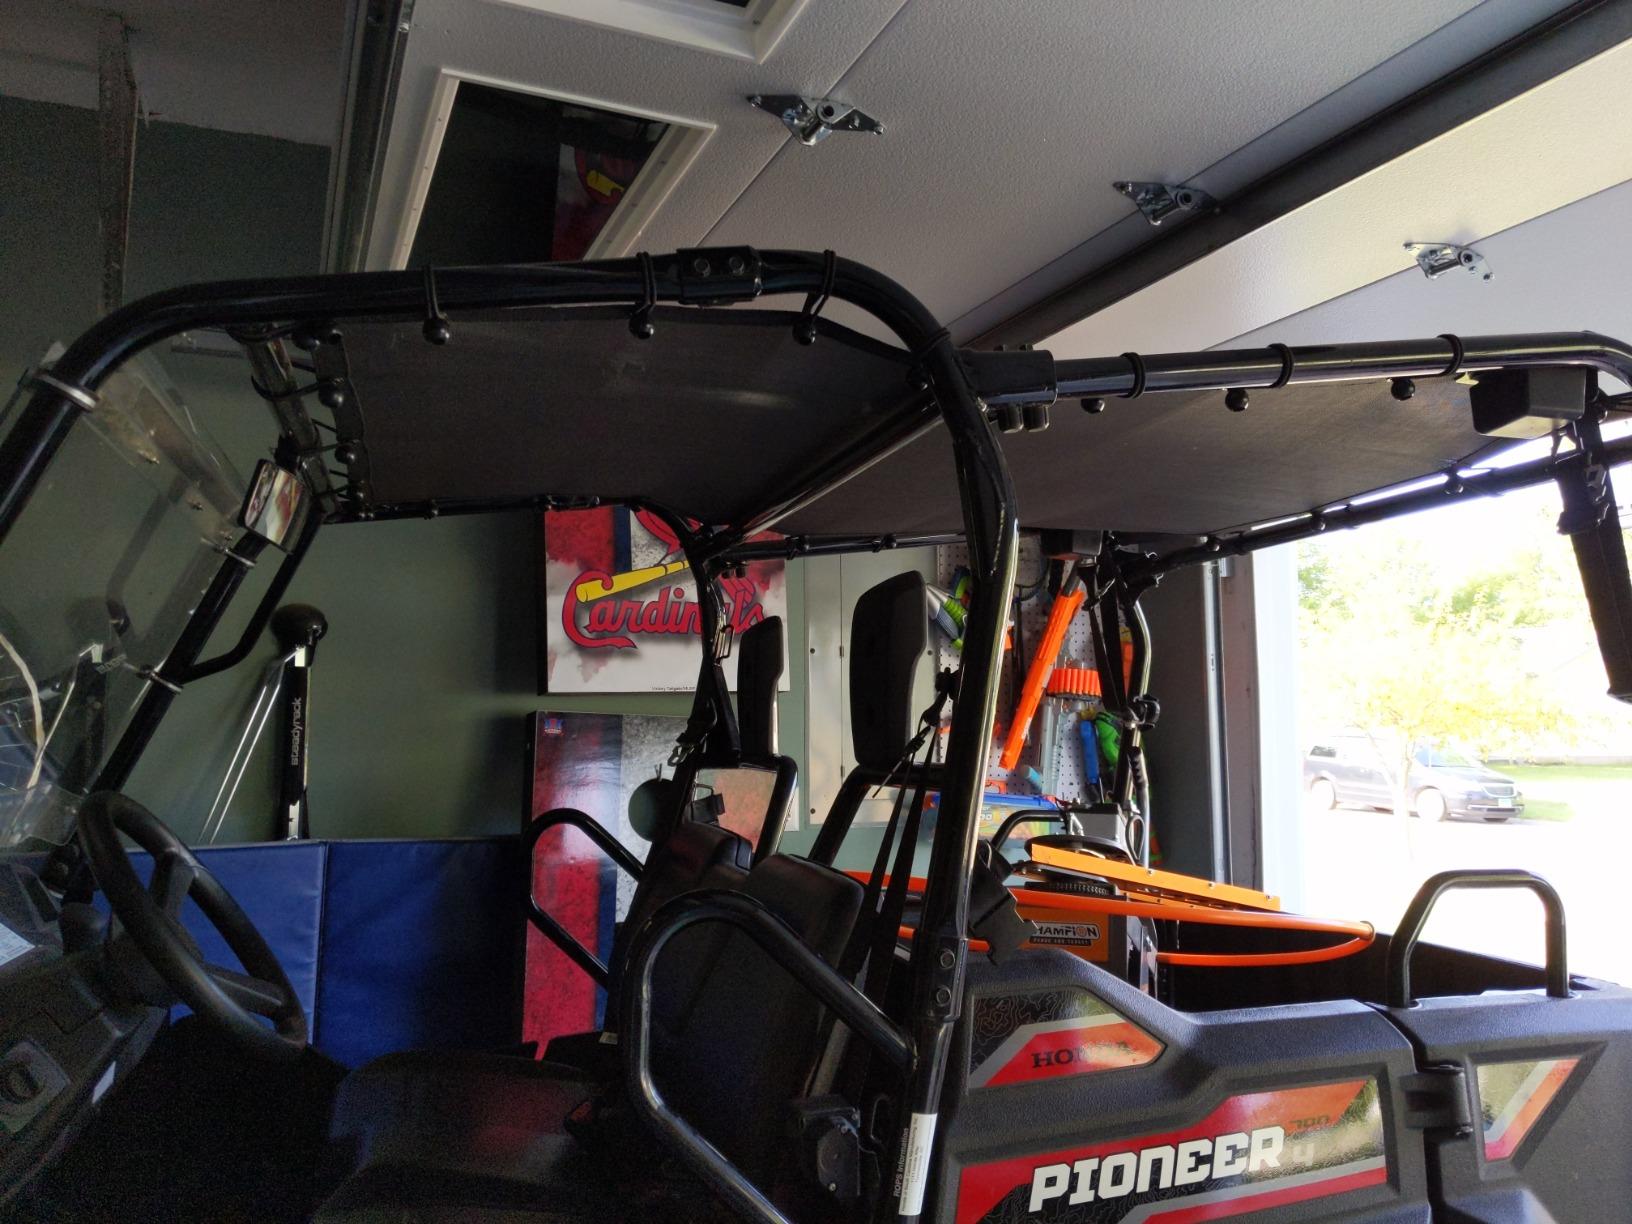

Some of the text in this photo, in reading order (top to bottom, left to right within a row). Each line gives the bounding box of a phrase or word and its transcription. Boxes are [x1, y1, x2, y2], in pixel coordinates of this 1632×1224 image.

[562, 569, 763, 649] Cardinls
[1038, 925, 1098, 937] HAMPION
[893, 1127, 909, 1198] ROPS Information
[1029, 1126, 1285, 1212] PIONEER
